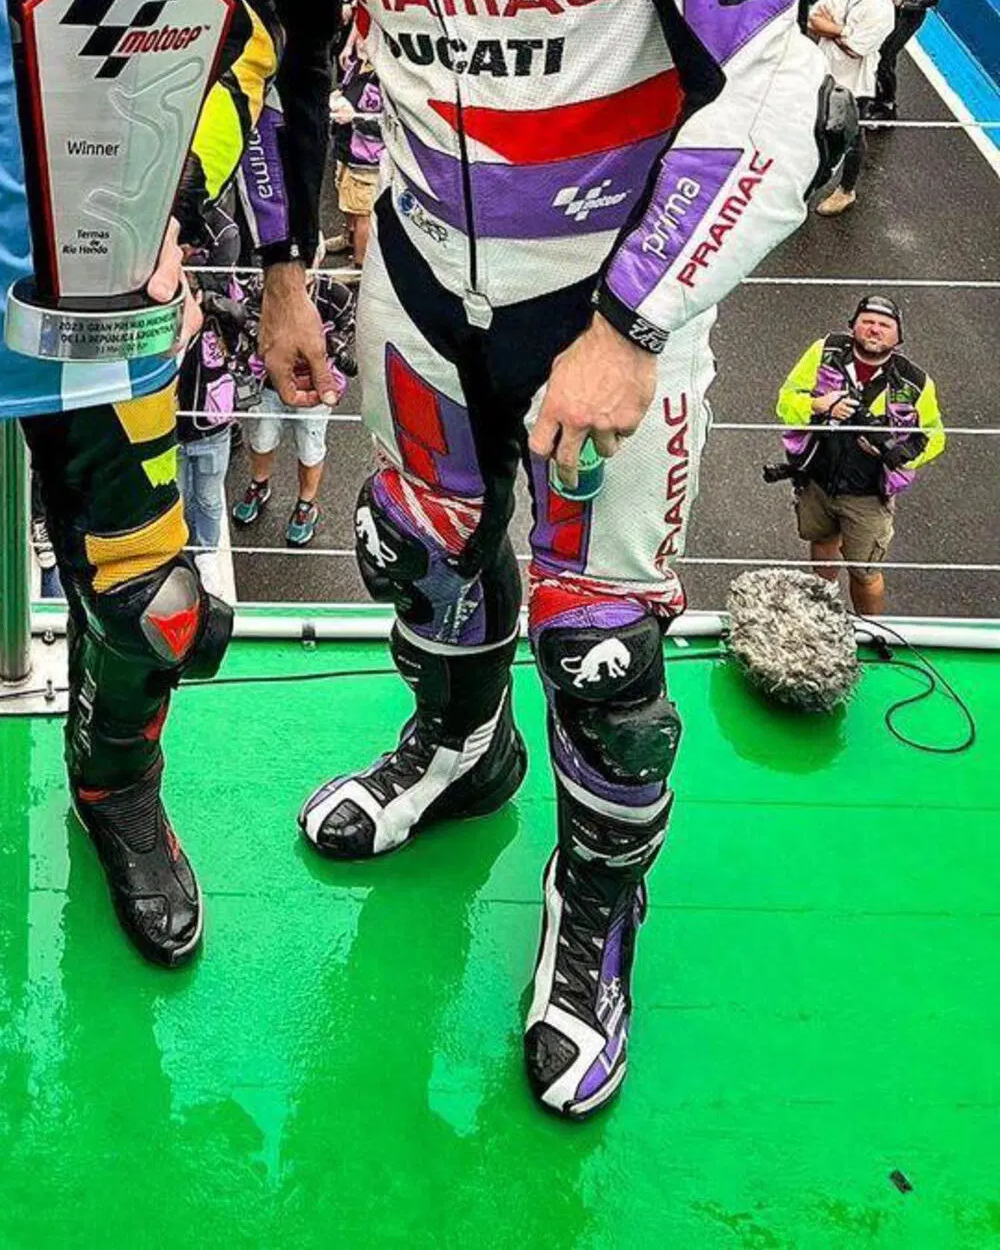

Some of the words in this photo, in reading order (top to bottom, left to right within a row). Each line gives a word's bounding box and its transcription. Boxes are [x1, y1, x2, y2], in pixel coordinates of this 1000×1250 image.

[67, 140, 120, 157] Winner
[641, 177, 700, 261] prima
[677, 150, 774, 288] PRAMAC
[77, 229, 110, 239] Termas
[79, 245, 108, 254] Hondo
[90, 239, 100, 247] de
